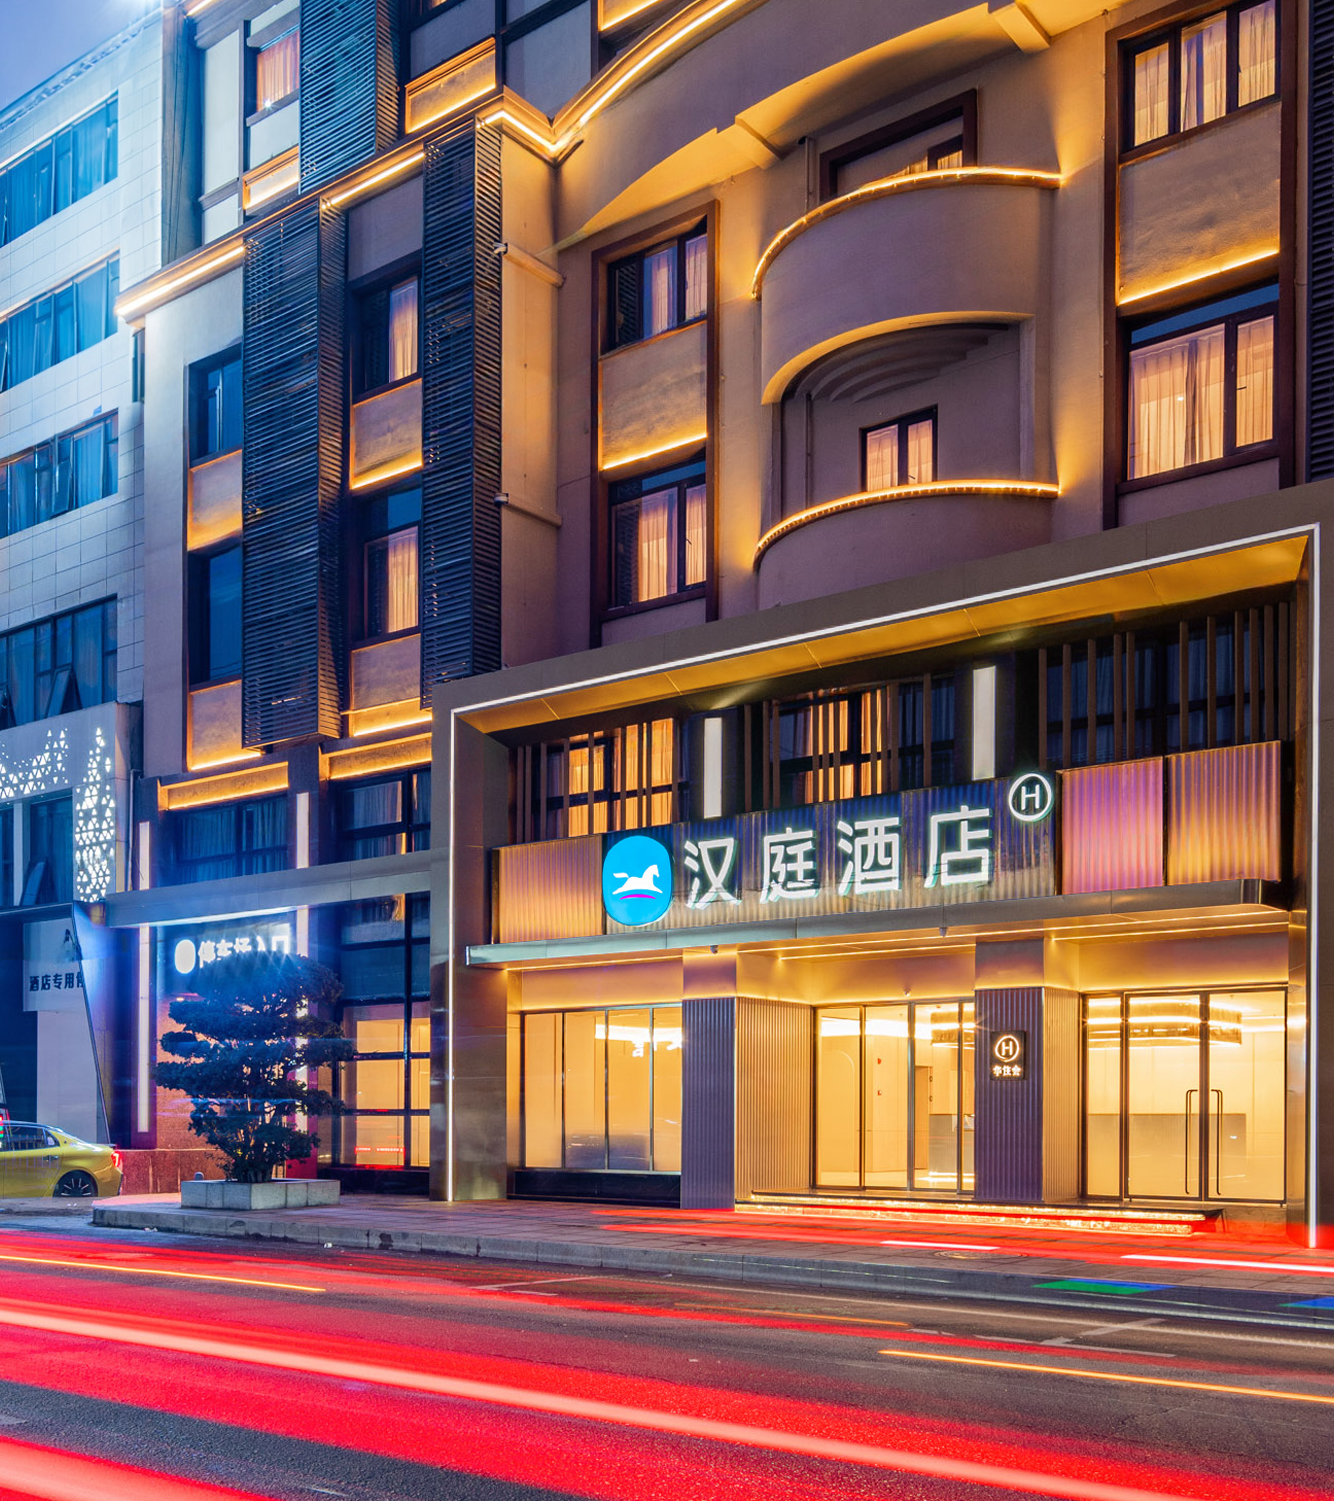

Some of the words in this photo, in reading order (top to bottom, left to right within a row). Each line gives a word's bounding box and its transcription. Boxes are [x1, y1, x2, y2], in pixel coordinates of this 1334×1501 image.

[684, 805, 993, 910] 汉庭酒店
[992, 1065, 1022, 1077] 华住会
